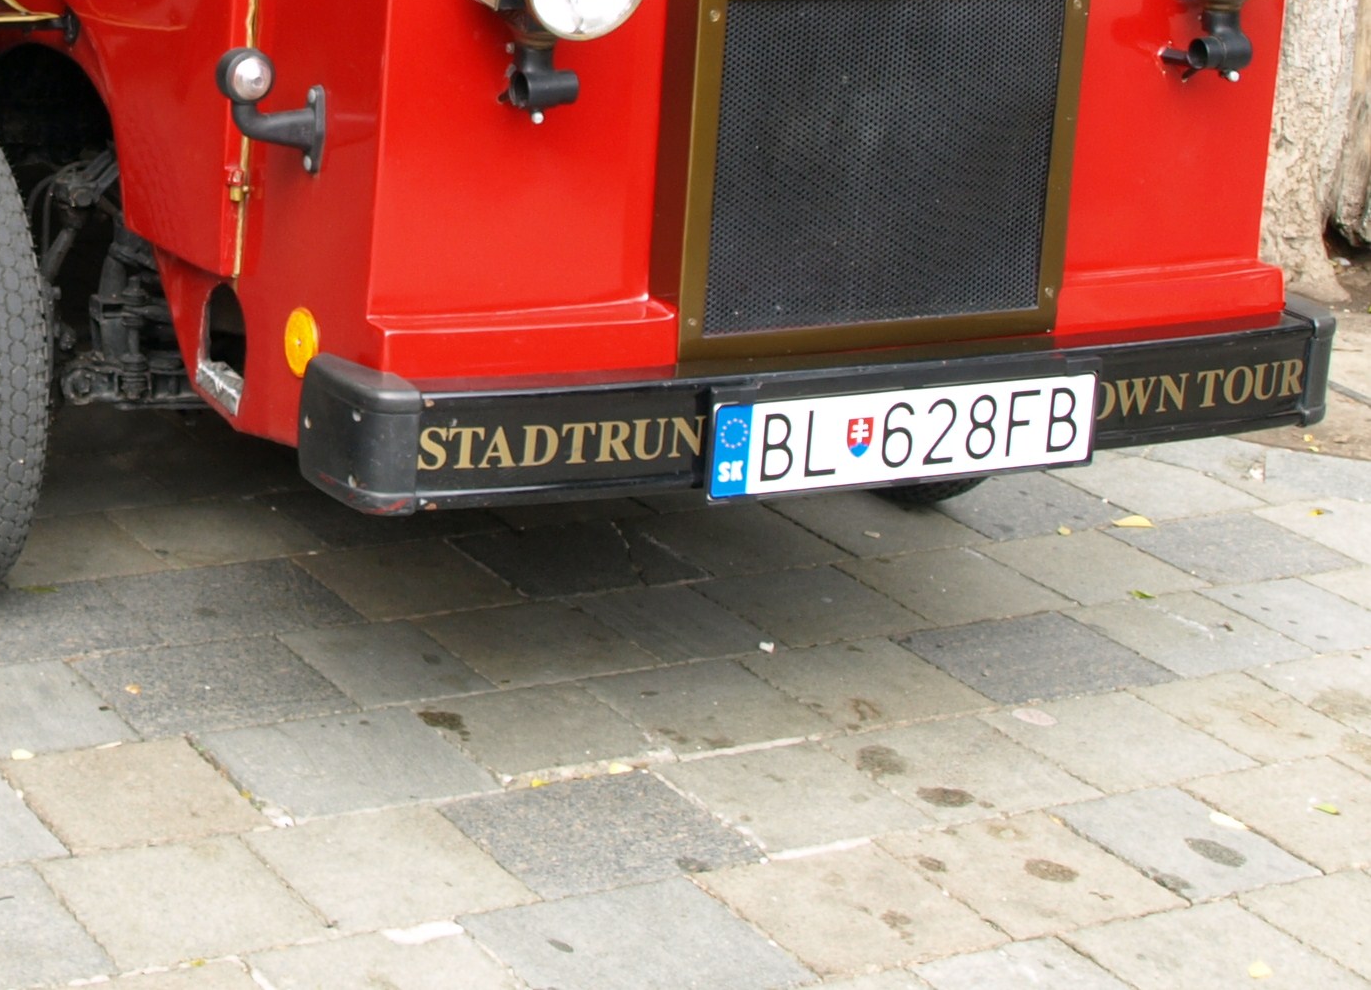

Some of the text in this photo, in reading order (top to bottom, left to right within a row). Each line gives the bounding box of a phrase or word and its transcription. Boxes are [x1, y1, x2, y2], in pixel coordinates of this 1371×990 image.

[1197, 359, 1307, 408] TOUR
[417, 415, 708, 470] STADTRUN
[759, 387, 1078, 482] BL 628FB
[718, 460, 744, 483] SK
